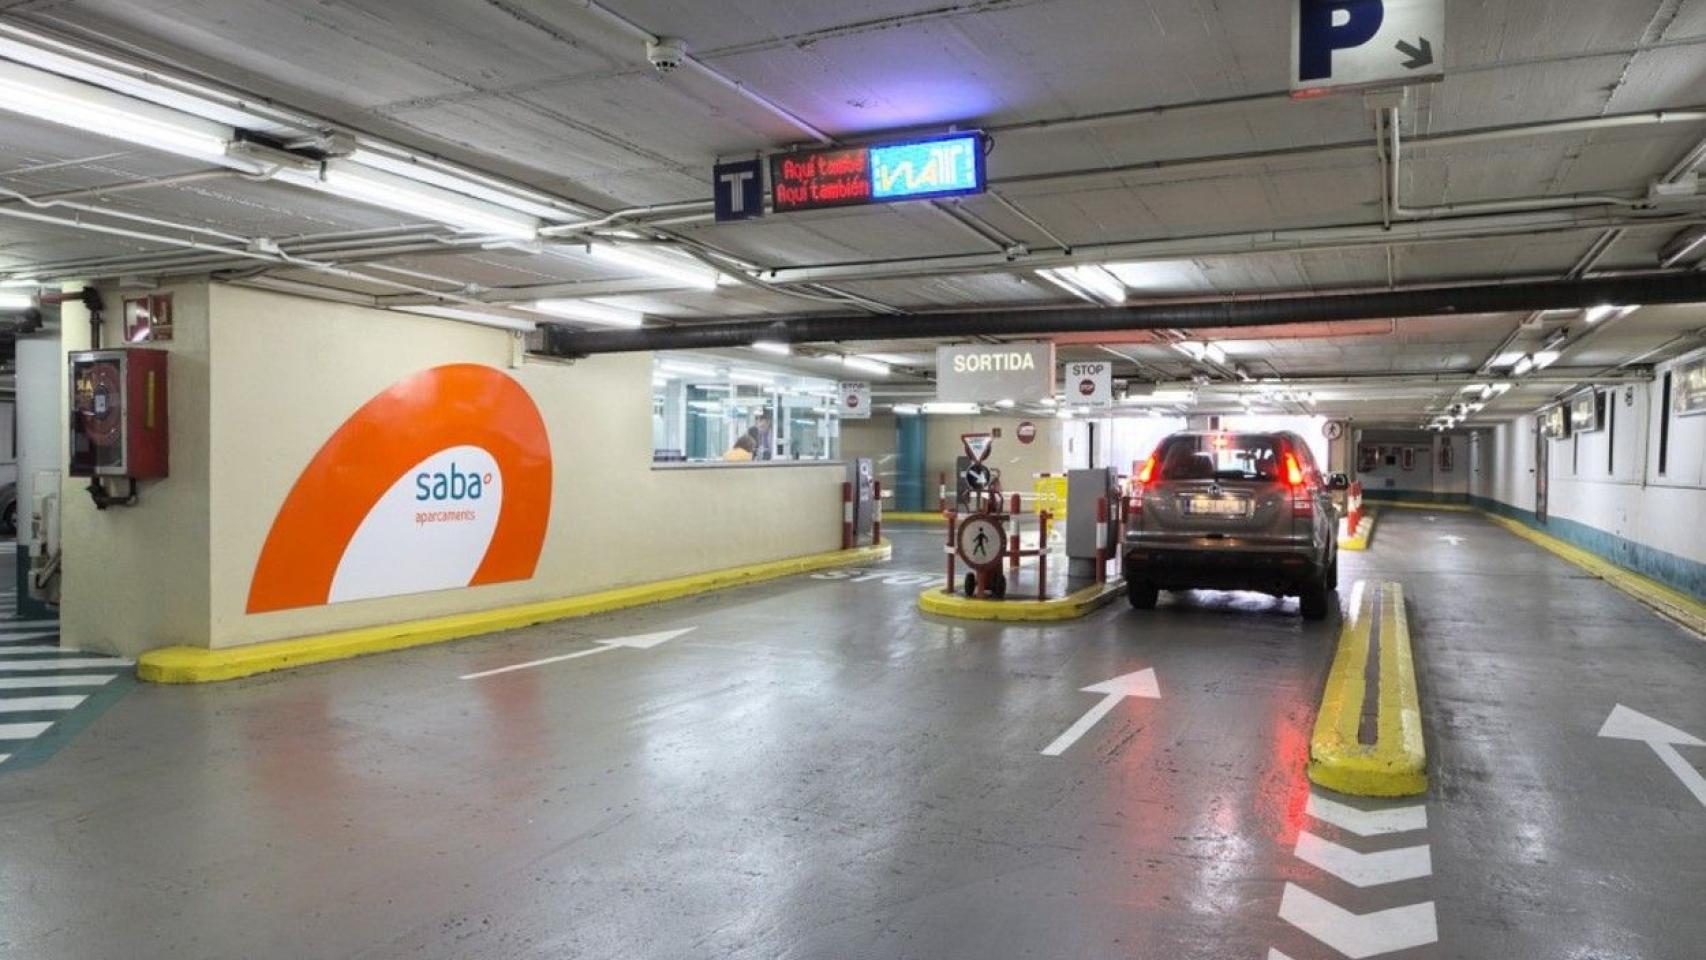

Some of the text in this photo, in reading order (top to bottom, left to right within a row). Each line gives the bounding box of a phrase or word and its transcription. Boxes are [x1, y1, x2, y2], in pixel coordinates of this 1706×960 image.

[1298, 0, 1385, 81] P
[720, 171, 754, 212] T
[953, 352, 1034, 372] SORTIDA
[1072, 364, 1104, 376] STOP
[416, 510, 476, 526] aparcaments
